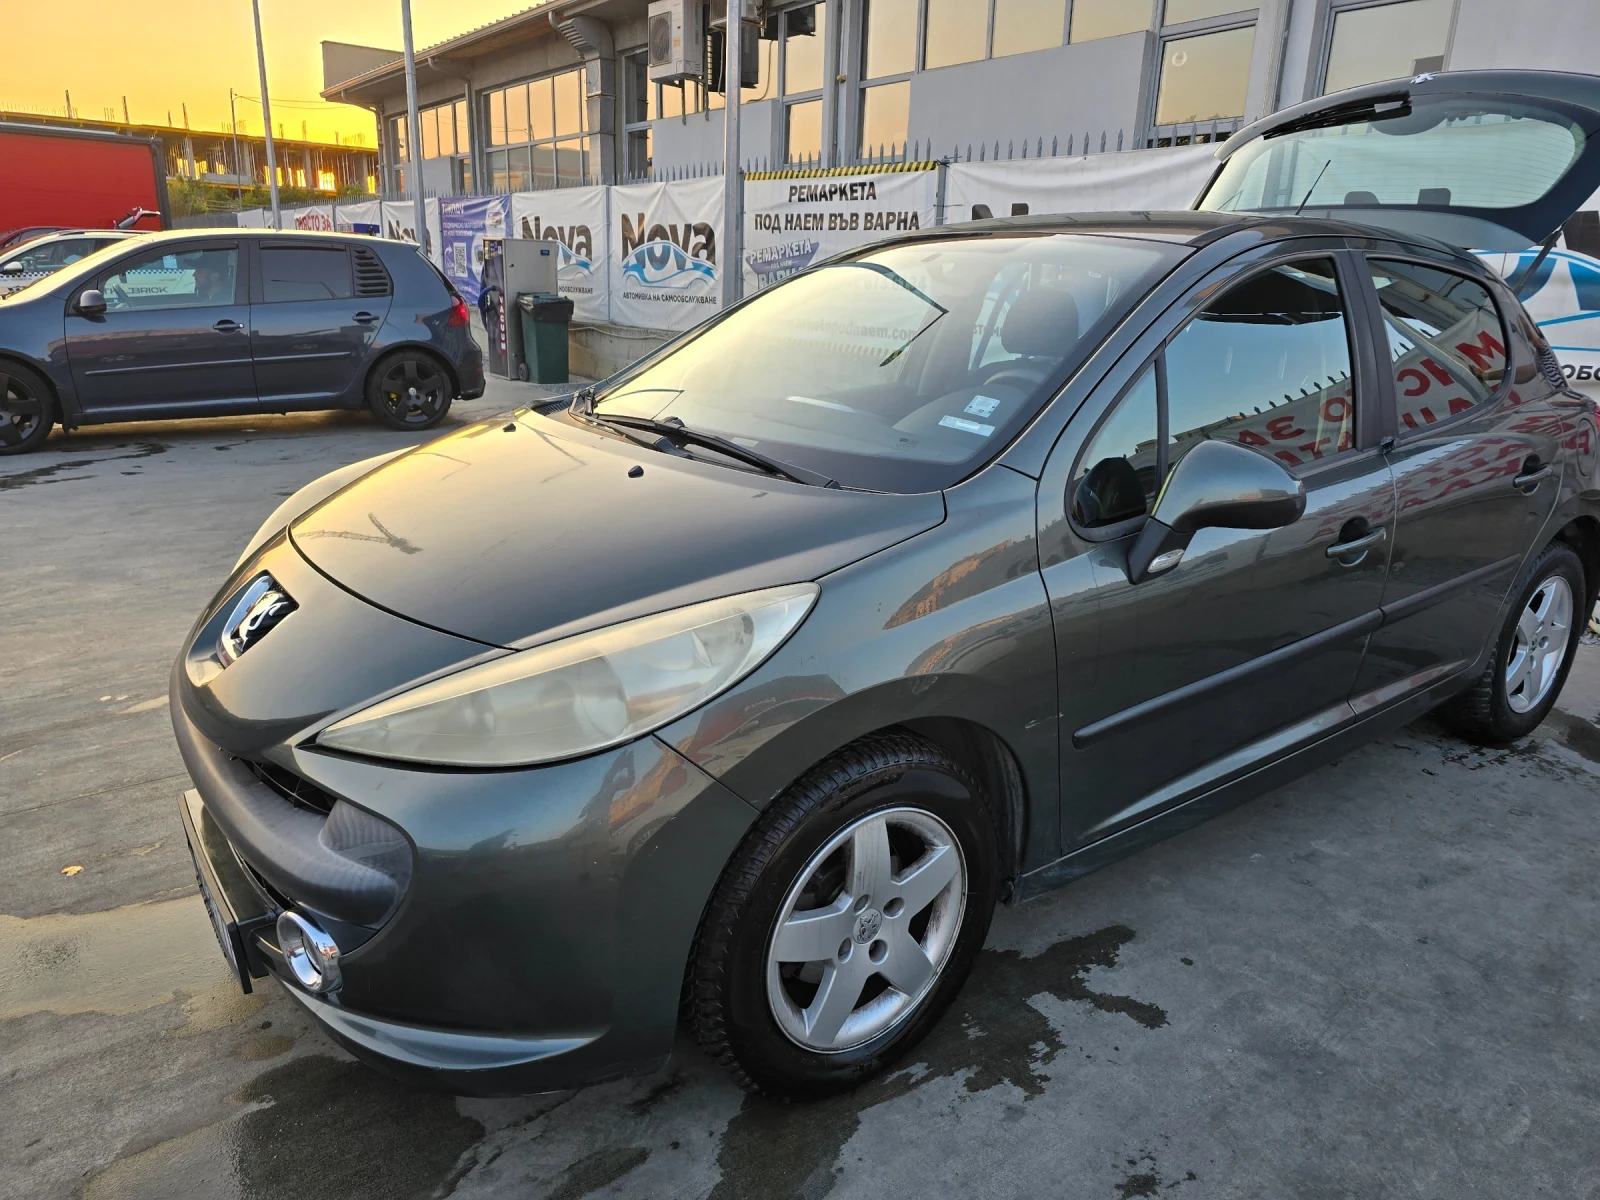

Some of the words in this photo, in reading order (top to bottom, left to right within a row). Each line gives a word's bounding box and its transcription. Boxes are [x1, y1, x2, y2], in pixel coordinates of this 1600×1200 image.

[788, 181, 877, 203] РЕМАРКЕТА
[754, 213, 782, 234] ПОД
[784, 213, 824, 231] НАЕМ
[828, 211, 860, 231] ВЪВ
[863, 210, 920, 231] ВАРНА
[621, 212, 716, 270] Nova
[749, 239, 812, 265] РЕМАРКЕТА
[623, 291, 652, 301] АВТОМИВКА
[652, 294, 661, 302] НА
[661, 295, 717, 305] САМООБСЛУЖВАНЕ
